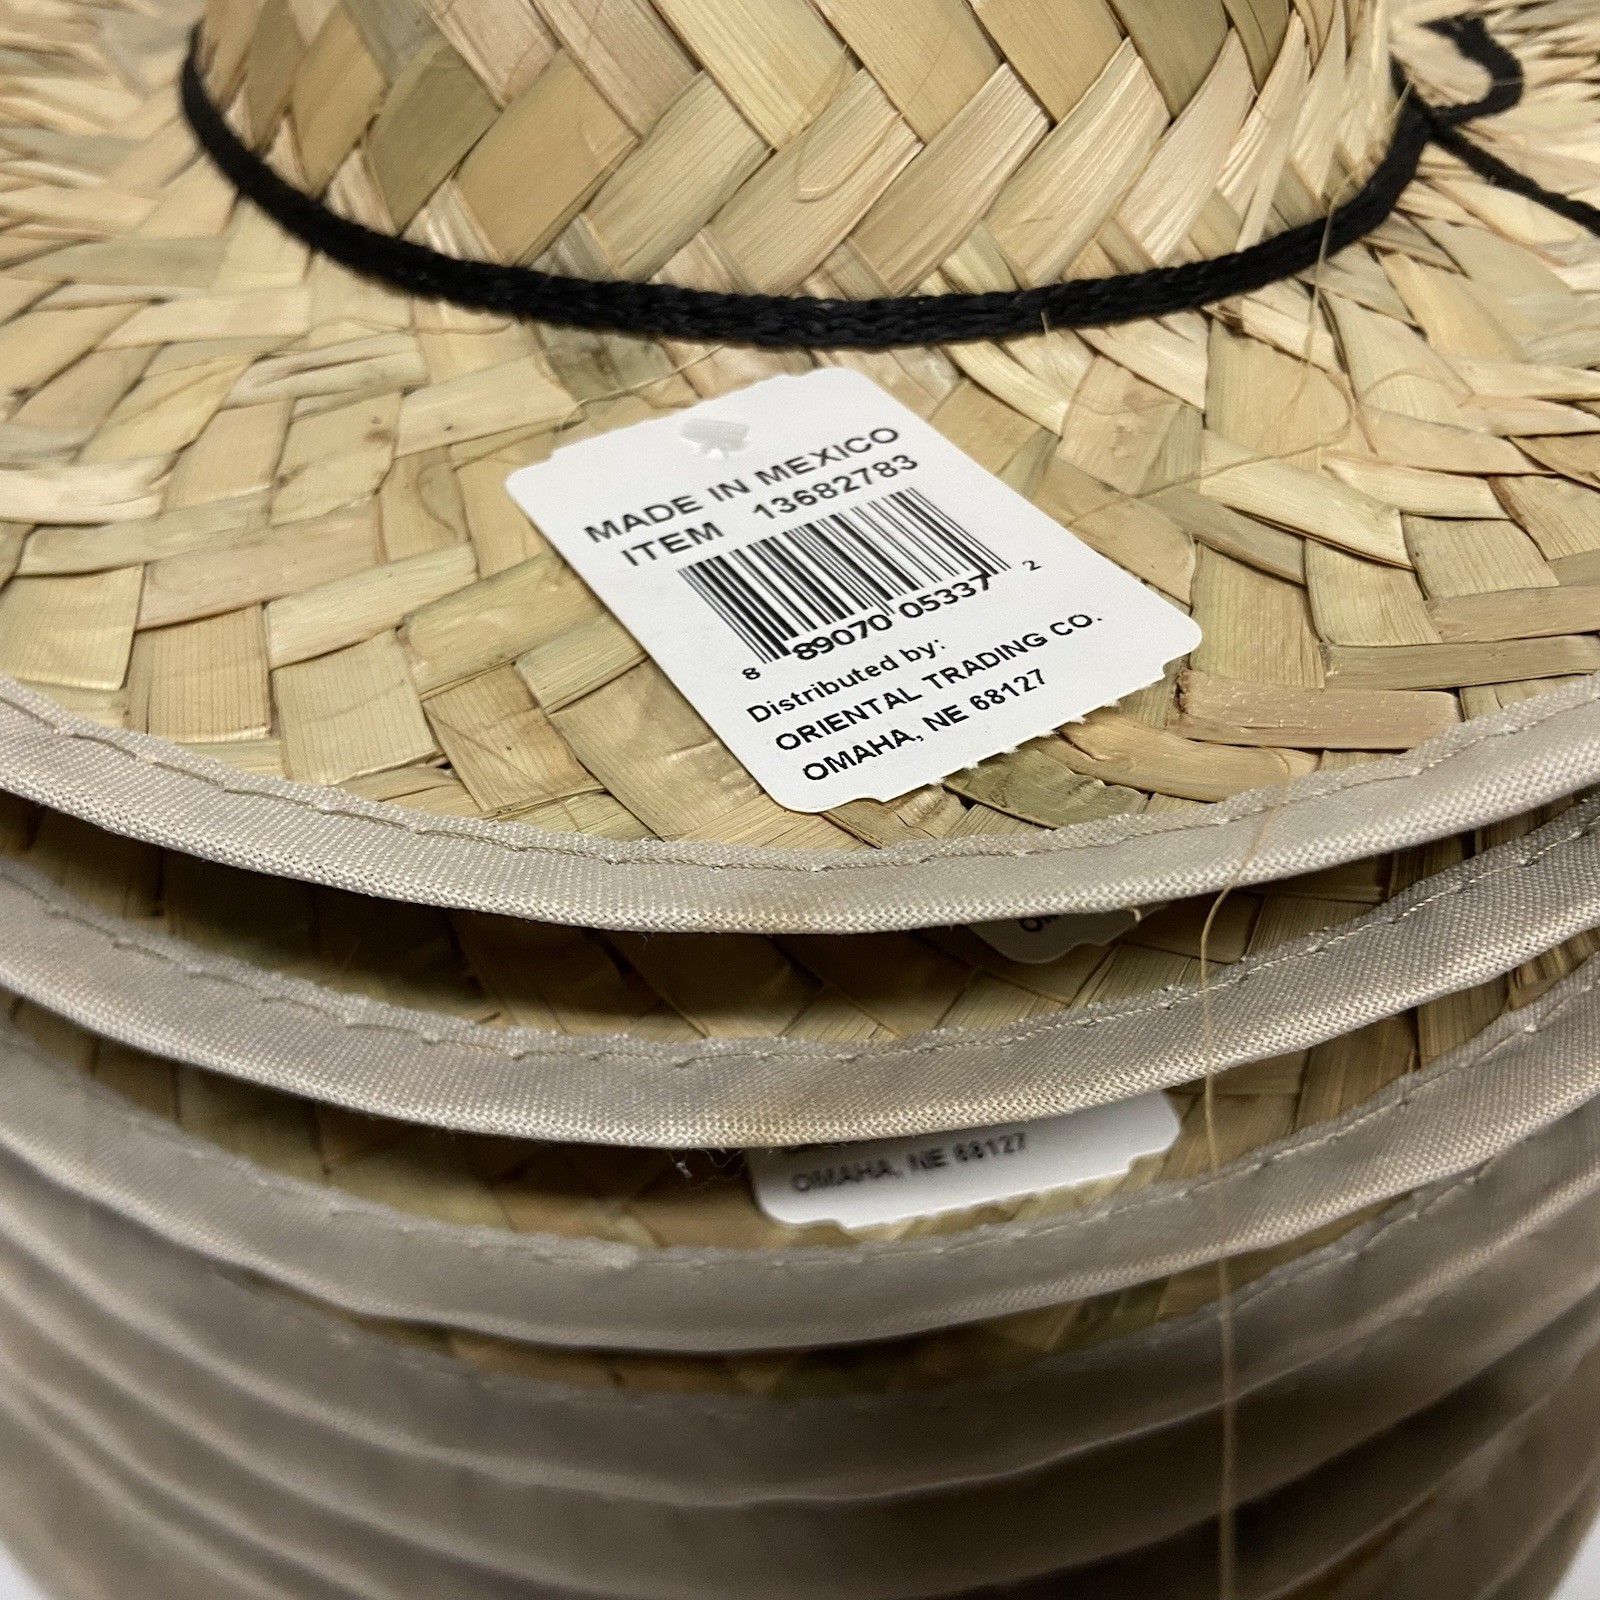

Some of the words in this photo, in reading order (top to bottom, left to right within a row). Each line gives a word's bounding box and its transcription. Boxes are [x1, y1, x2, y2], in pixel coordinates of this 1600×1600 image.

[584, 495, 703, 543] MADE
[707, 479, 751, 502] IN
[754, 428, 899, 485] MEXICO
[622, 522, 724, 566] ITEM
[752, 455, 918, 520] 13682783
[742, 667, 761, 680] 8
[793, 614, 893, 660] 89070
[899, 572, 992, 618] 05337
[1022, 560, 1042, 571] 2
[746, 657, 899, 723] Distributed
[900, 639, 946, 662] by:
[775, 687, 922, 750] ORIENTAL
[921, 633, 1047, 689] TRADING
[1050, 613, 1103, 636] CO.
[803, 729, 924, 780] OMAHA,
[922, 705, 969, 731] NE
[969, 669, 1047, 710] 68127
[907, 1146, 948, 1171] NE
